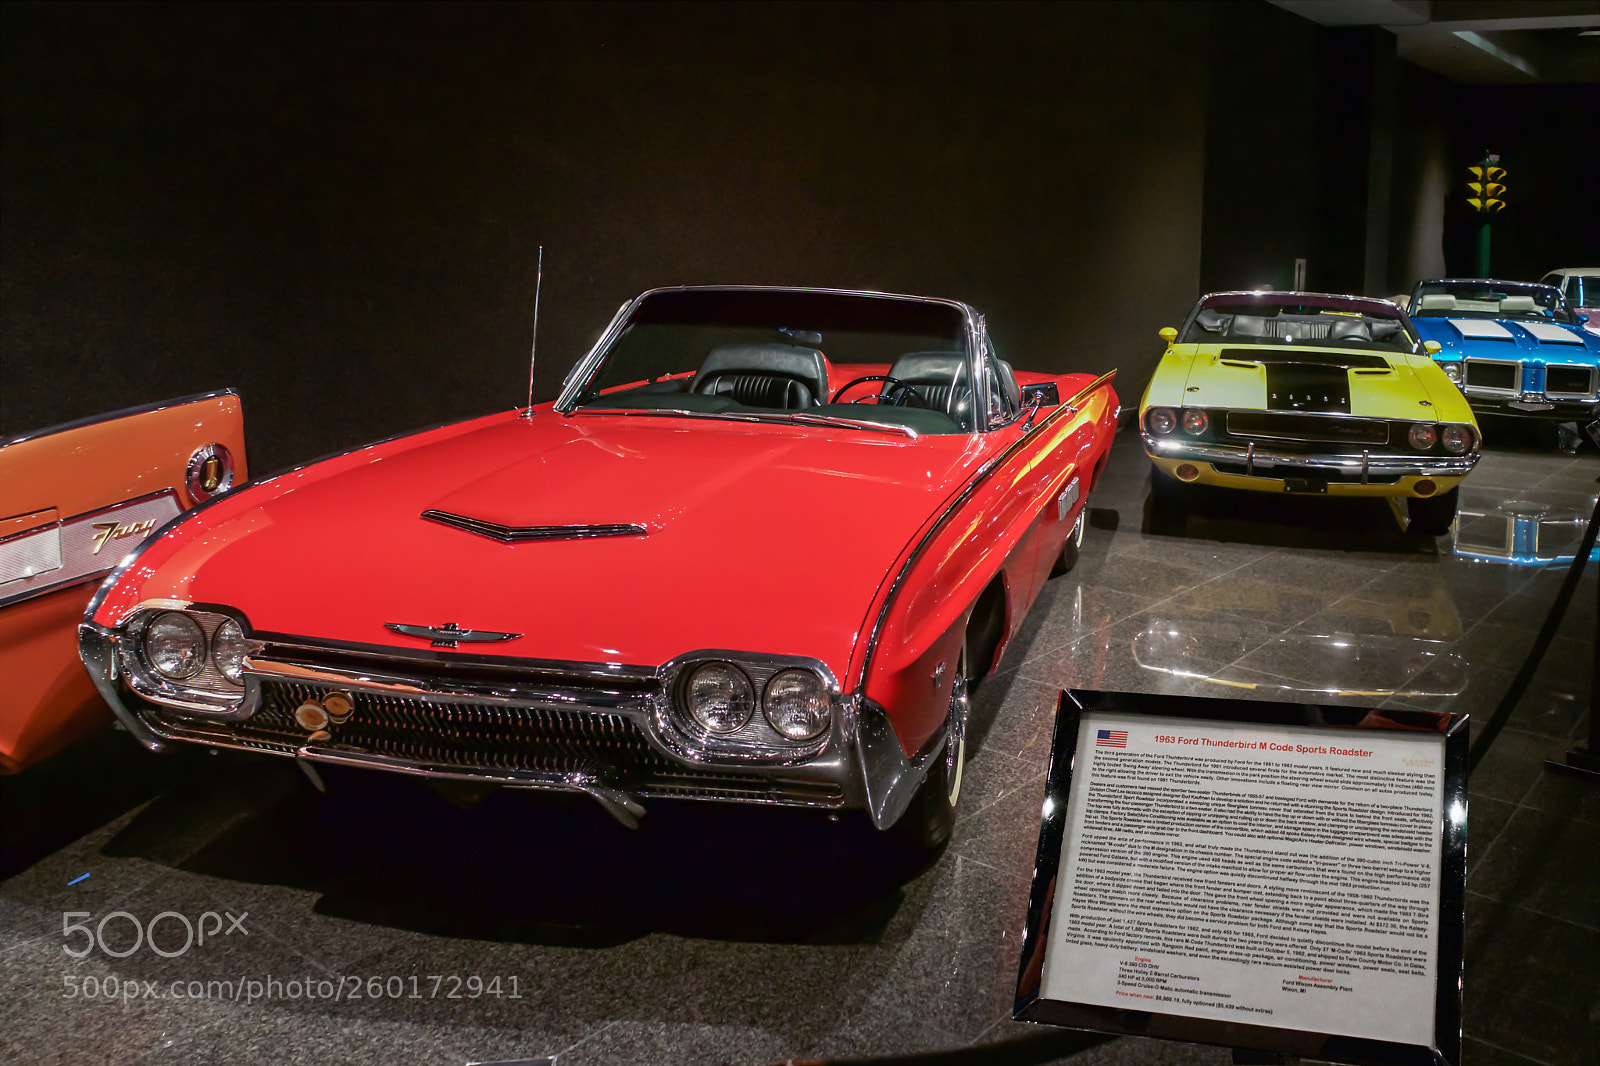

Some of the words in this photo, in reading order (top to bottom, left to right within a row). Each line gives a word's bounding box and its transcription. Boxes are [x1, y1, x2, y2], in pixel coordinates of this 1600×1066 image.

[1200, 738, 1257, 748] Thunderbird
[1269, 743, 1294, 751] Code
[1295, 745, 1327, 754] Sports
[1329, 747, 1372, 756] Roadster
